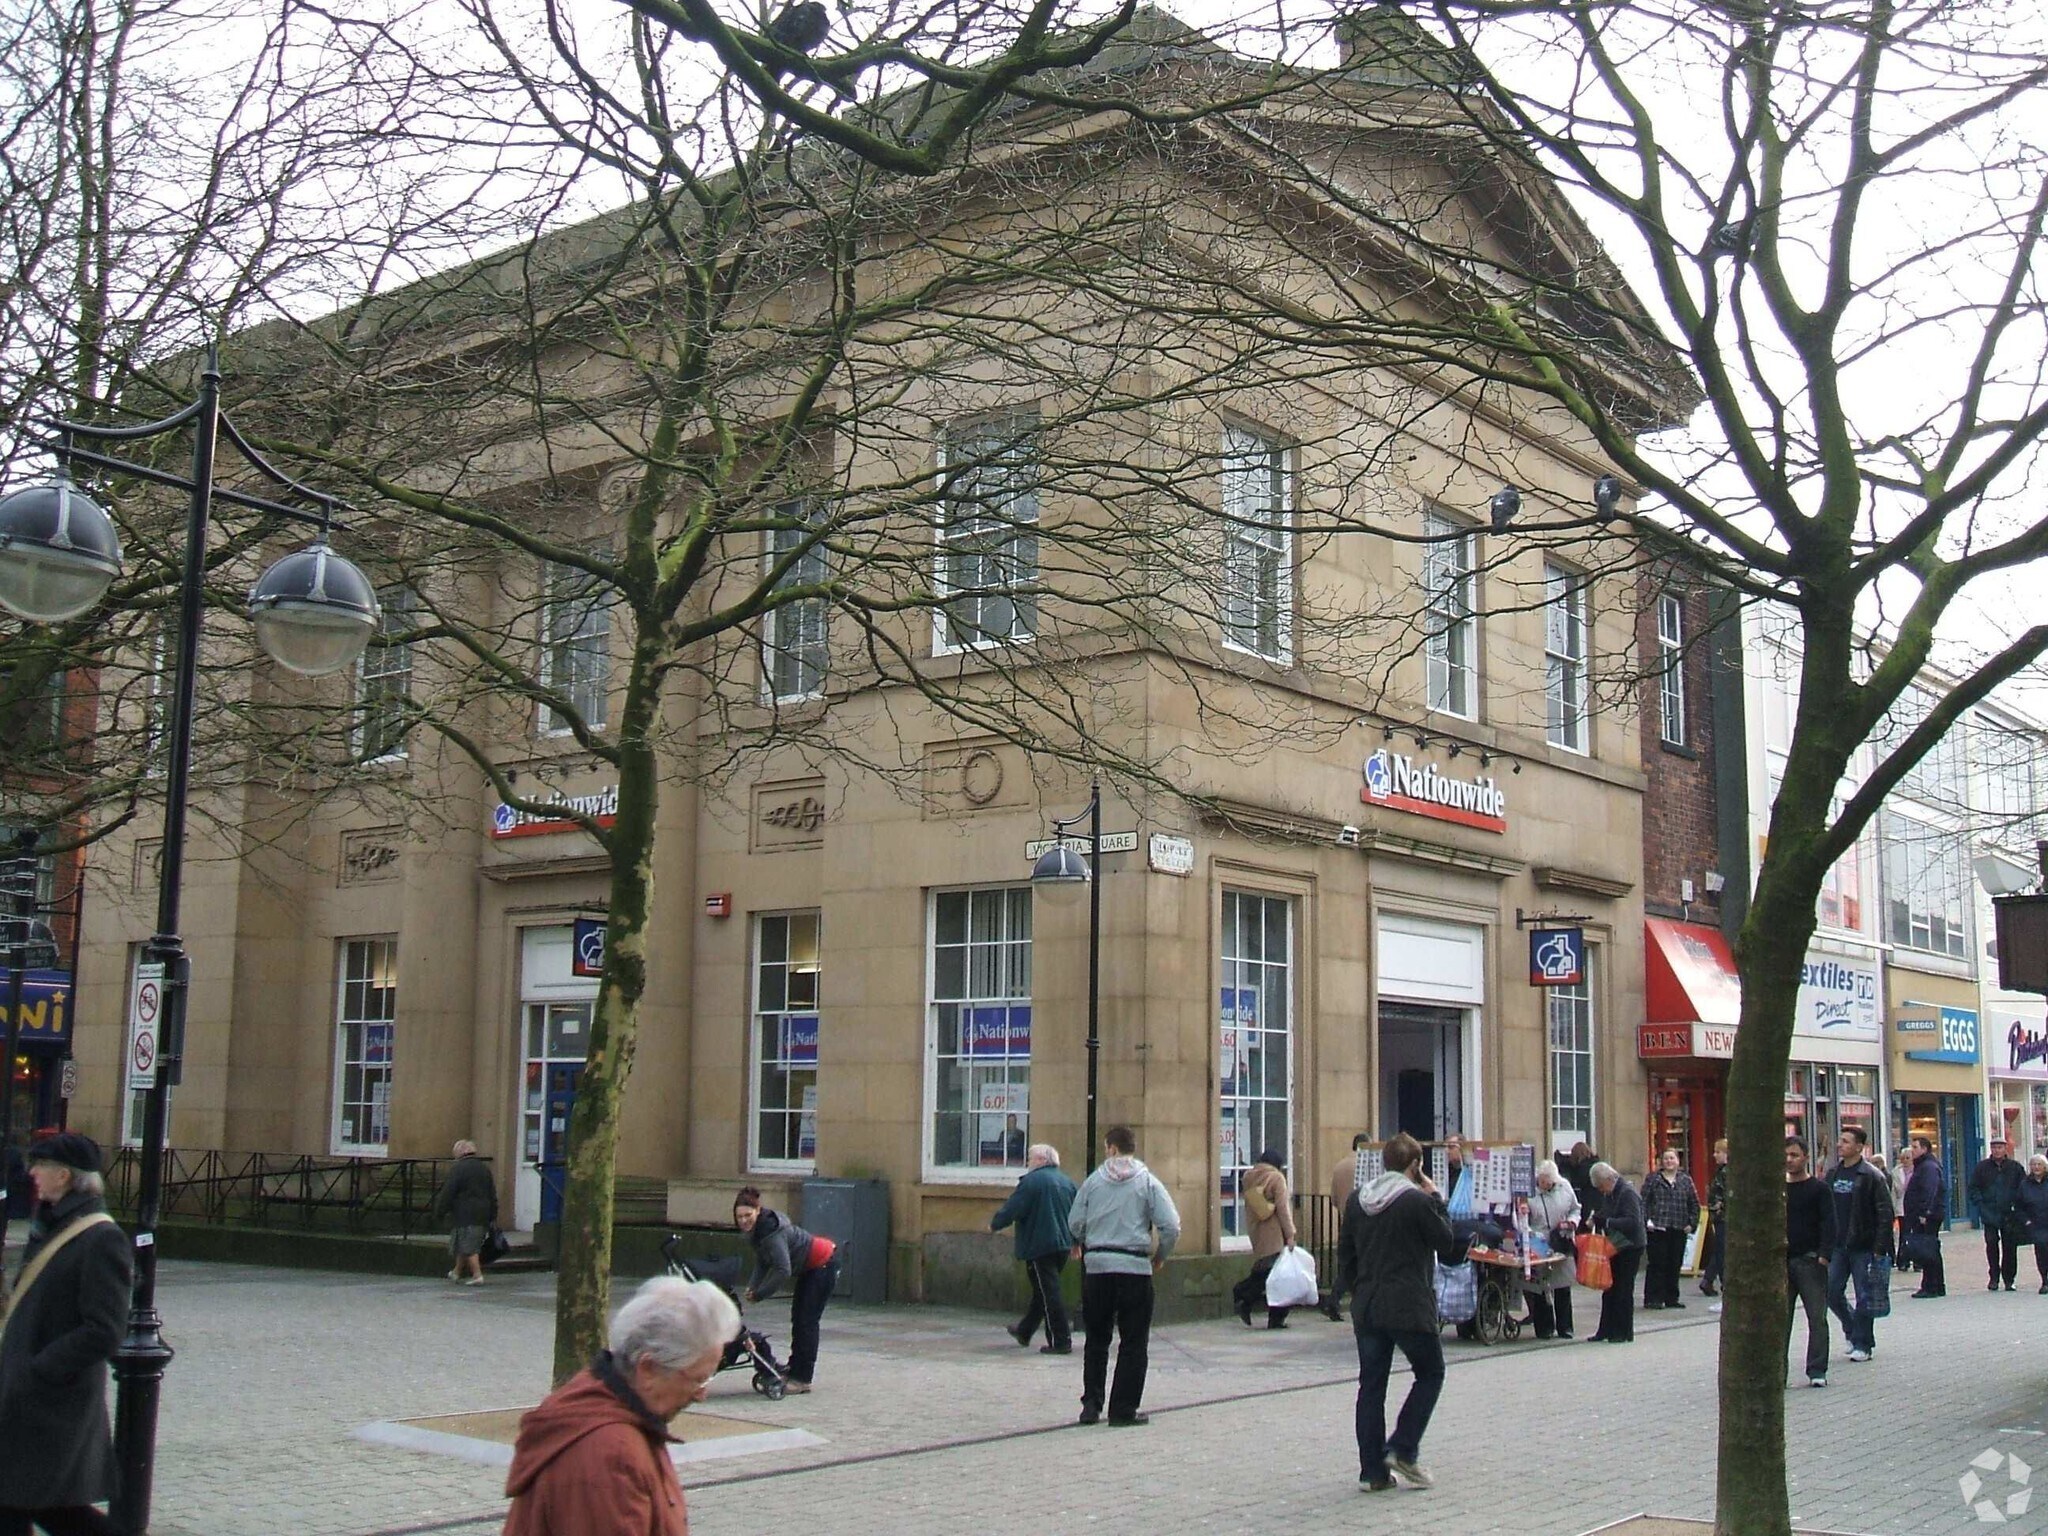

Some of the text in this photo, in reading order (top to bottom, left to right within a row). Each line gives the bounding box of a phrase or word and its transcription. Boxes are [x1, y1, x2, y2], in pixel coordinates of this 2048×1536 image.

[1393, 753, 1505, 817] Nationwide
[1088, 836, 1130, 850] SUARE
[1800, 961, 1854, 991] extiles
[1815, 997, 1853, 1020] Direct
[1905, 1021, 1935, 1030] GREGGS
[1941, 1017, 1975, 1053] EGGS
[1643, 1030, 1734, 1051] BEN NEW
